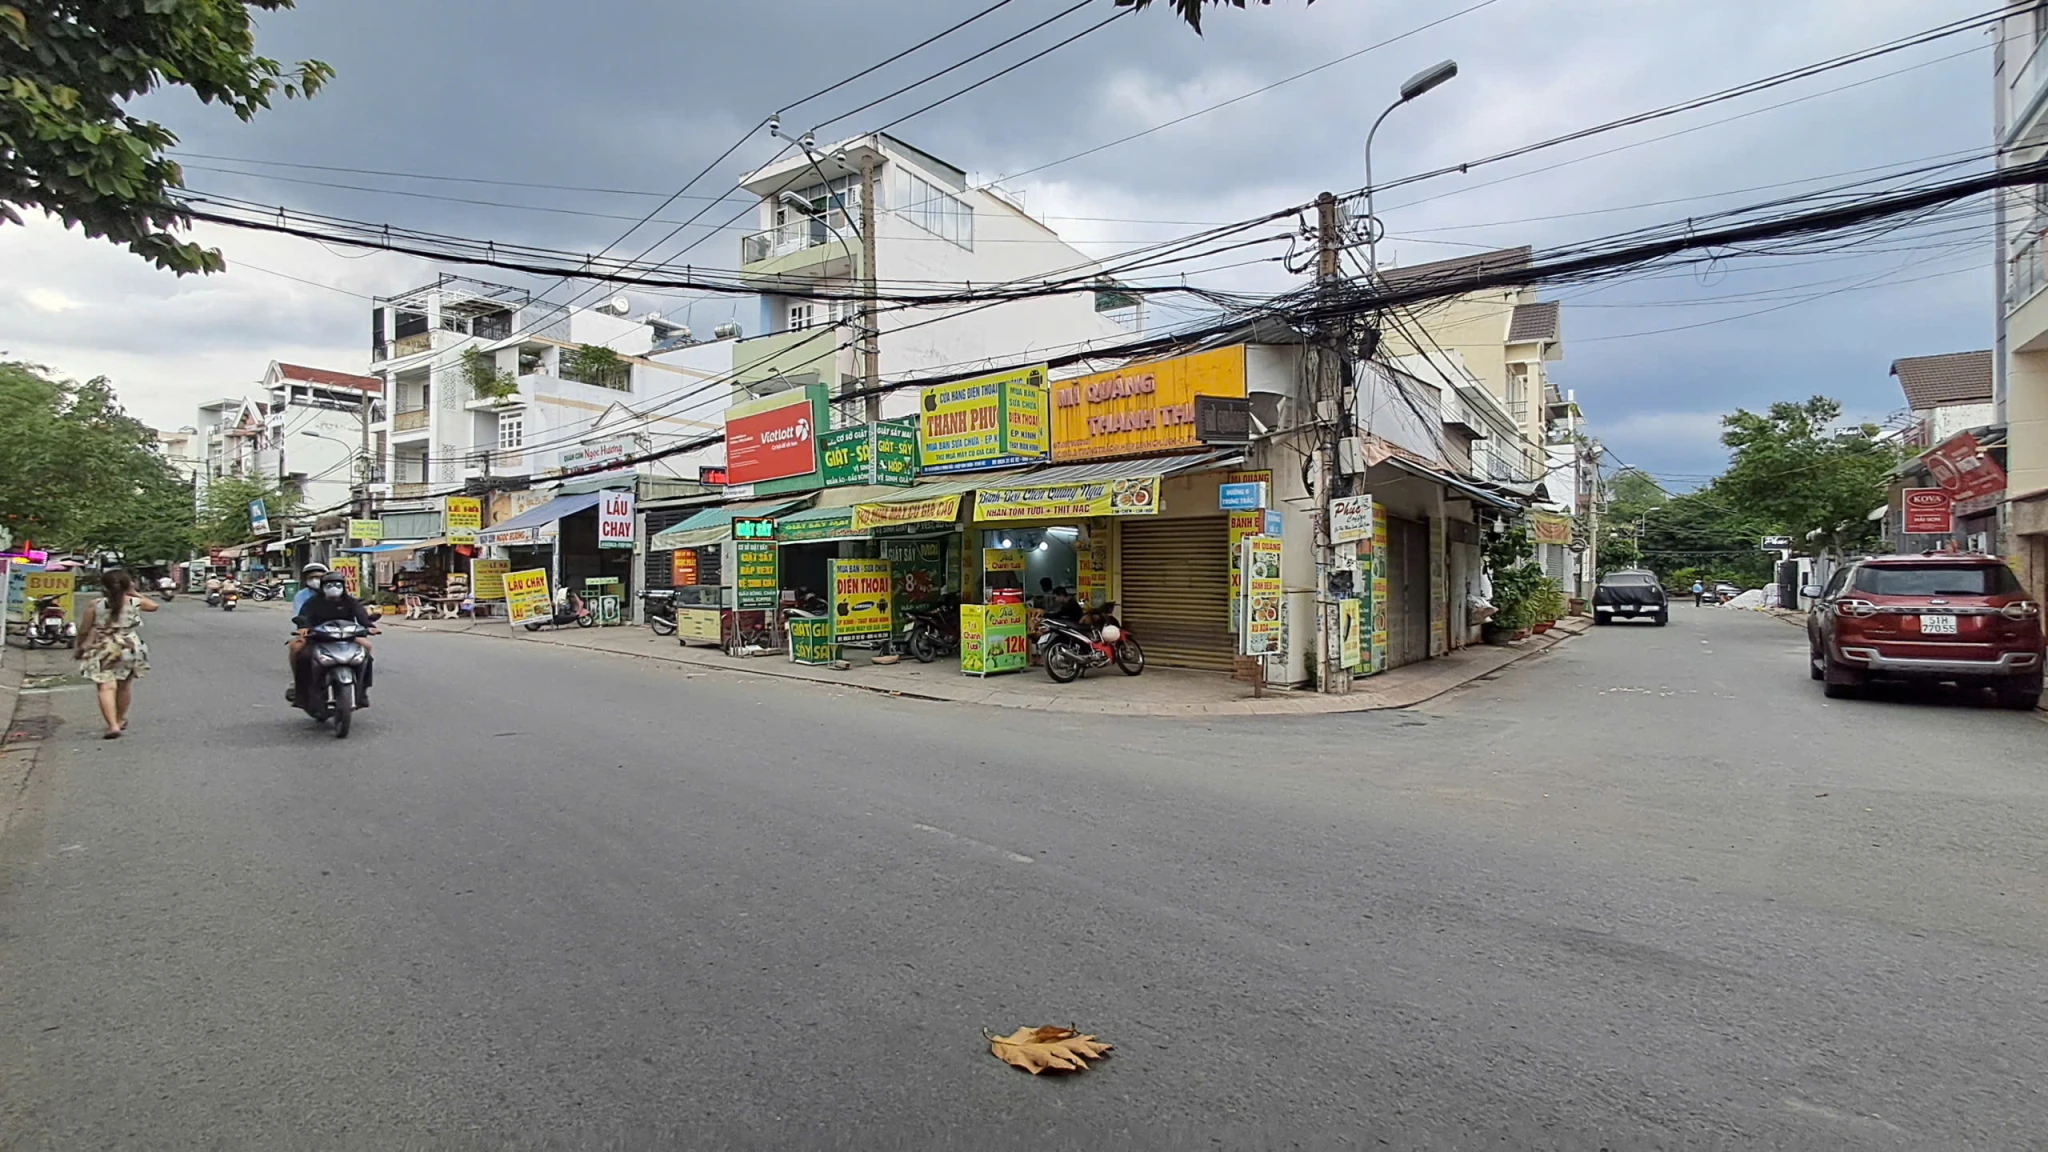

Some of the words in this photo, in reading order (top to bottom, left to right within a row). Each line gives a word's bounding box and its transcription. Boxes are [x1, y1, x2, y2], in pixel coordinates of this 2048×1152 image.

[927, 410, 968, 438] THANH
[1087, 406, 1157, 437] THANH
[761, 426, 795, 445] Vietlott
[584, 447, 601, 461] Ngọc
[606, 493, 628, 517] LẨU
[1913, 495, 1942, 503] KOVA
[602, 521, 632, 538] CHAY
[1928, 616, 1948, 625] 51H
[963, 631, 981, 641] Chanh
